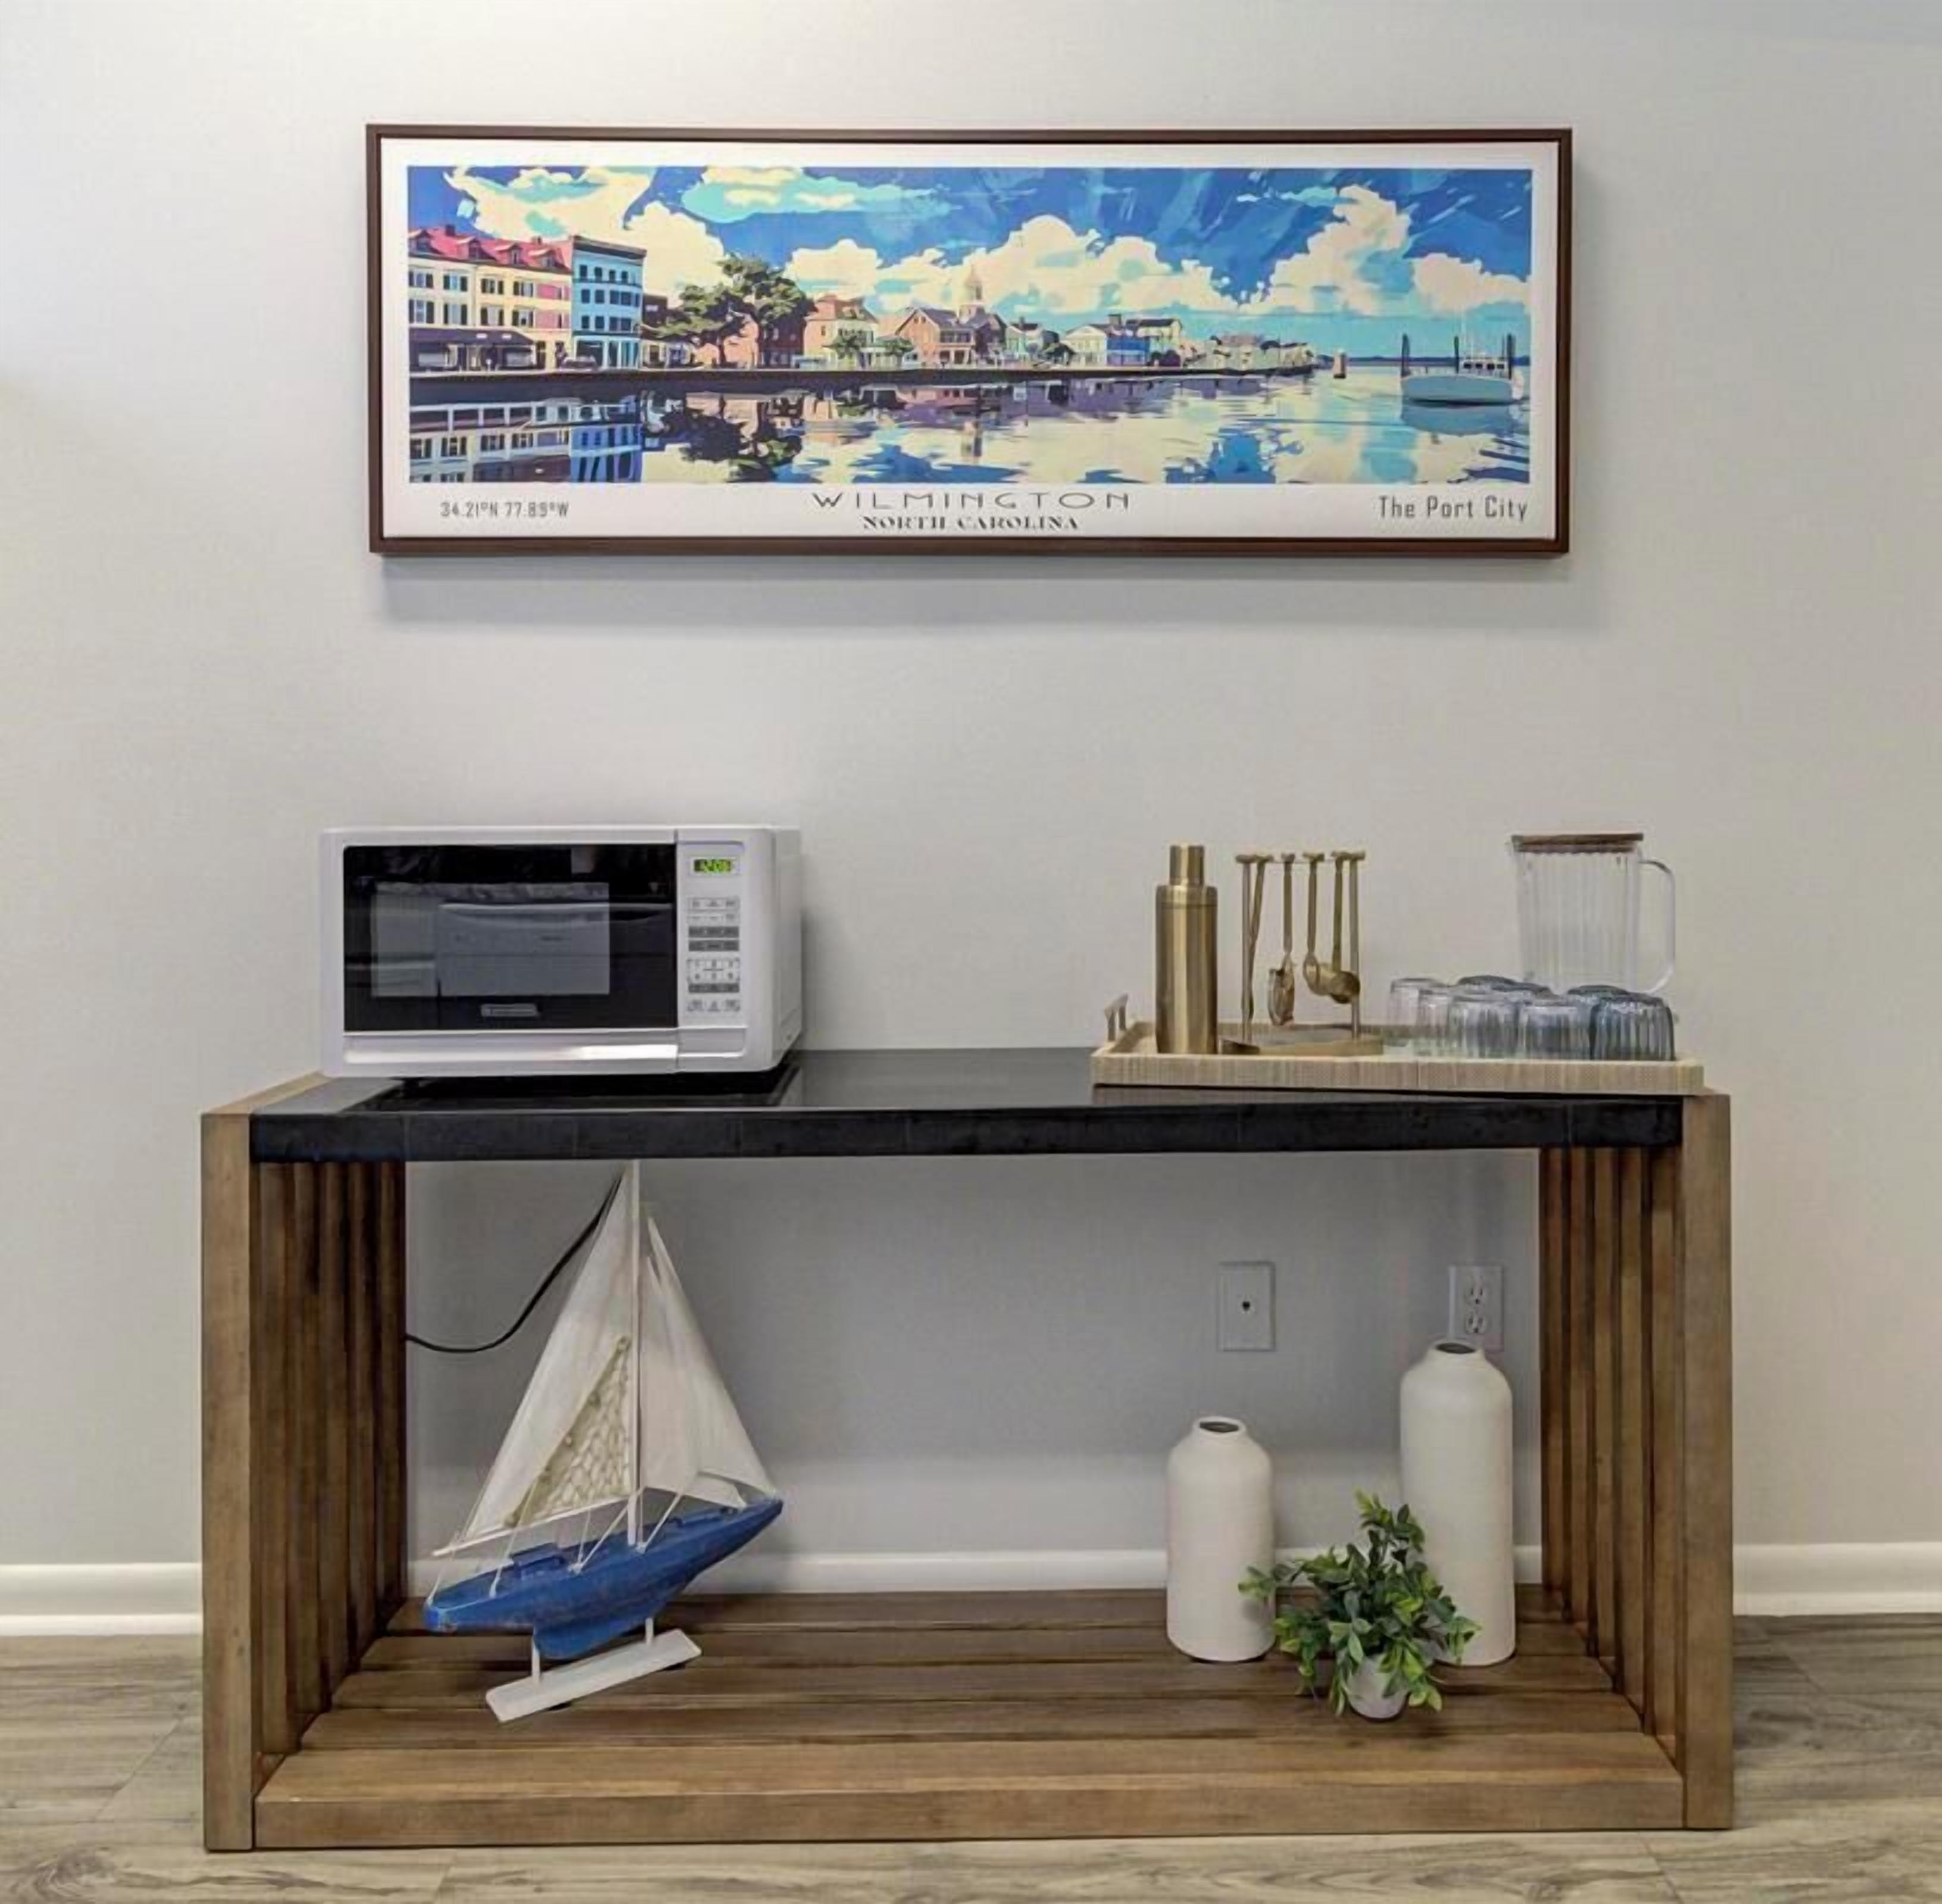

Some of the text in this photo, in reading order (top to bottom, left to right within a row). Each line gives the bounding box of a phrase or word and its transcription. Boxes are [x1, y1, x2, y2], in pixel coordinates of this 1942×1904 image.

[812, 491, 1129, 509] WILMINGTON
[1379, 495, 1528, 521] The Port City
[863, 516, 1078, 530] NORTH CAROLINA
